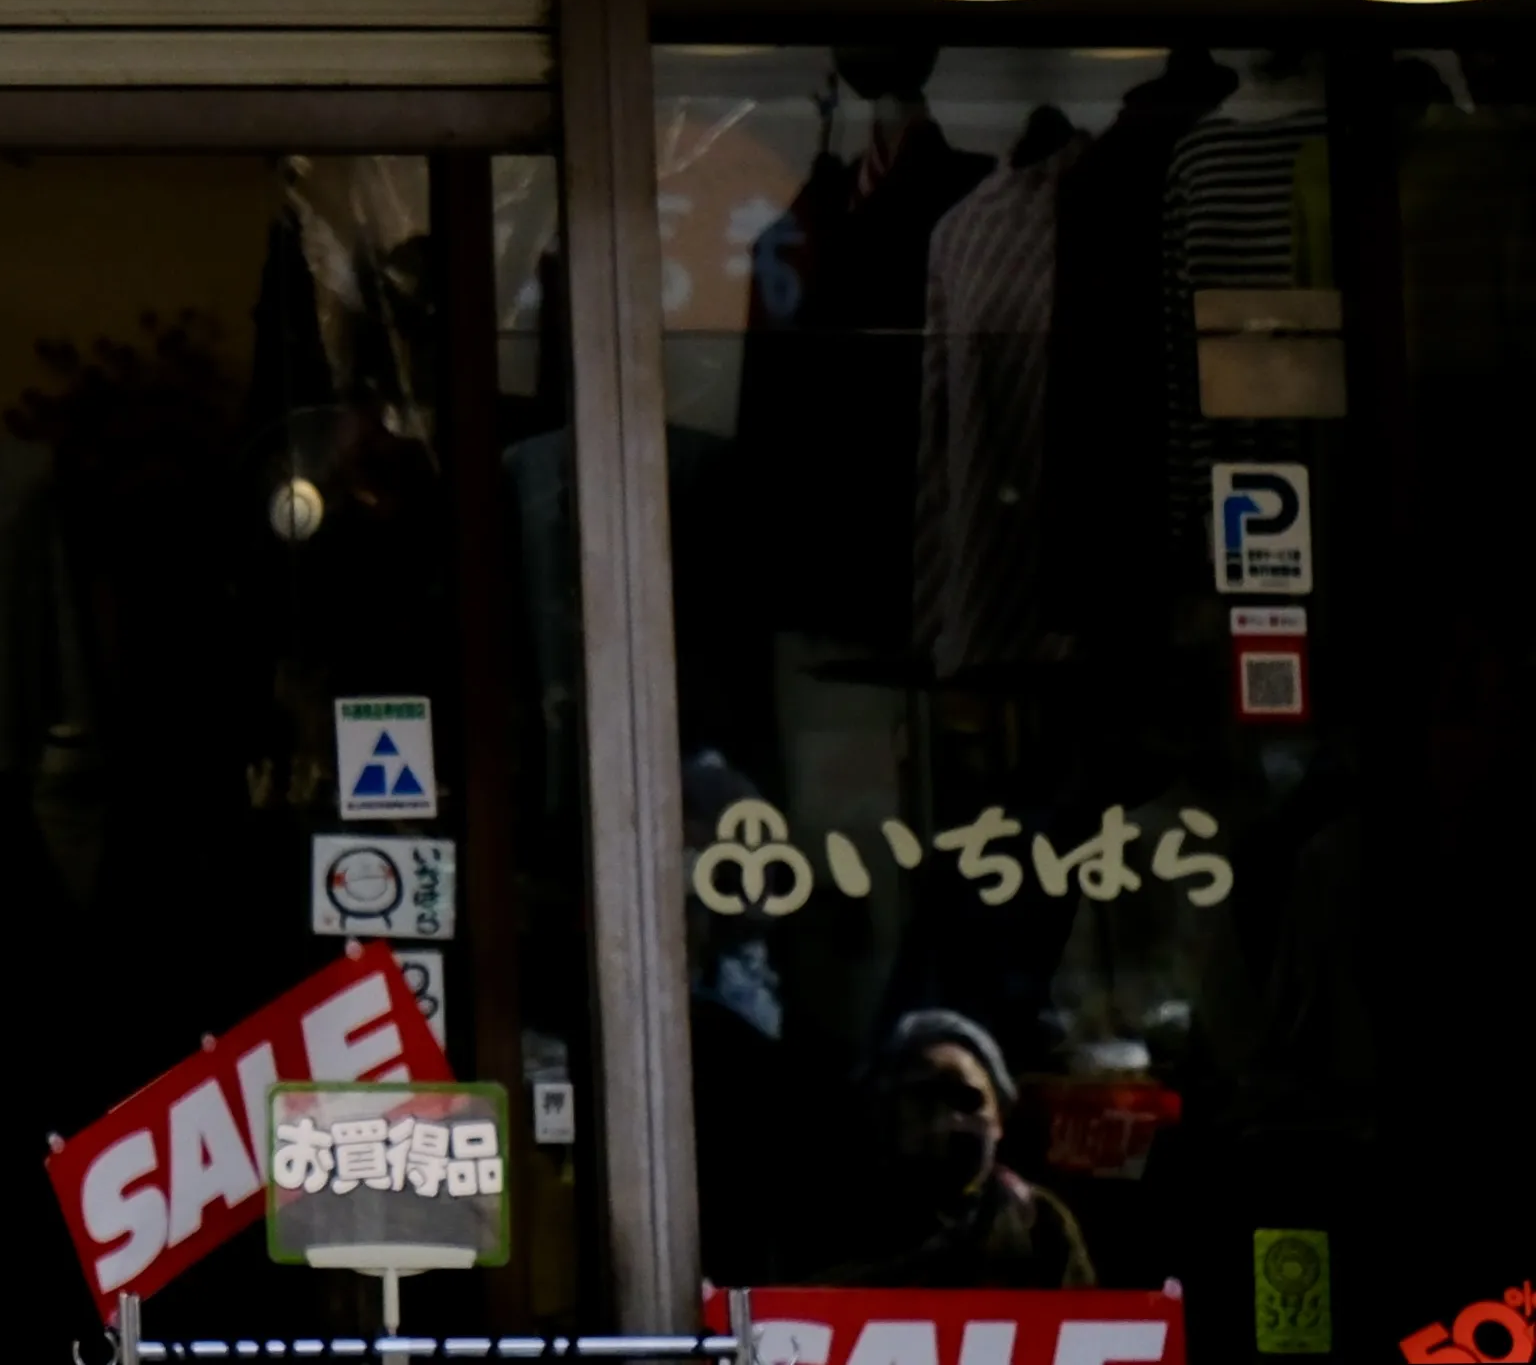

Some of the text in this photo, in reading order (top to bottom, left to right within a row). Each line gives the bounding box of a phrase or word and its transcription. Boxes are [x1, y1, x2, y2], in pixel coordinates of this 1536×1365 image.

[826, 803, 1235, 907] いちはら
[80, 971, 416, 1295] SALE
[272, 1117, 504, 1198] お買得品
